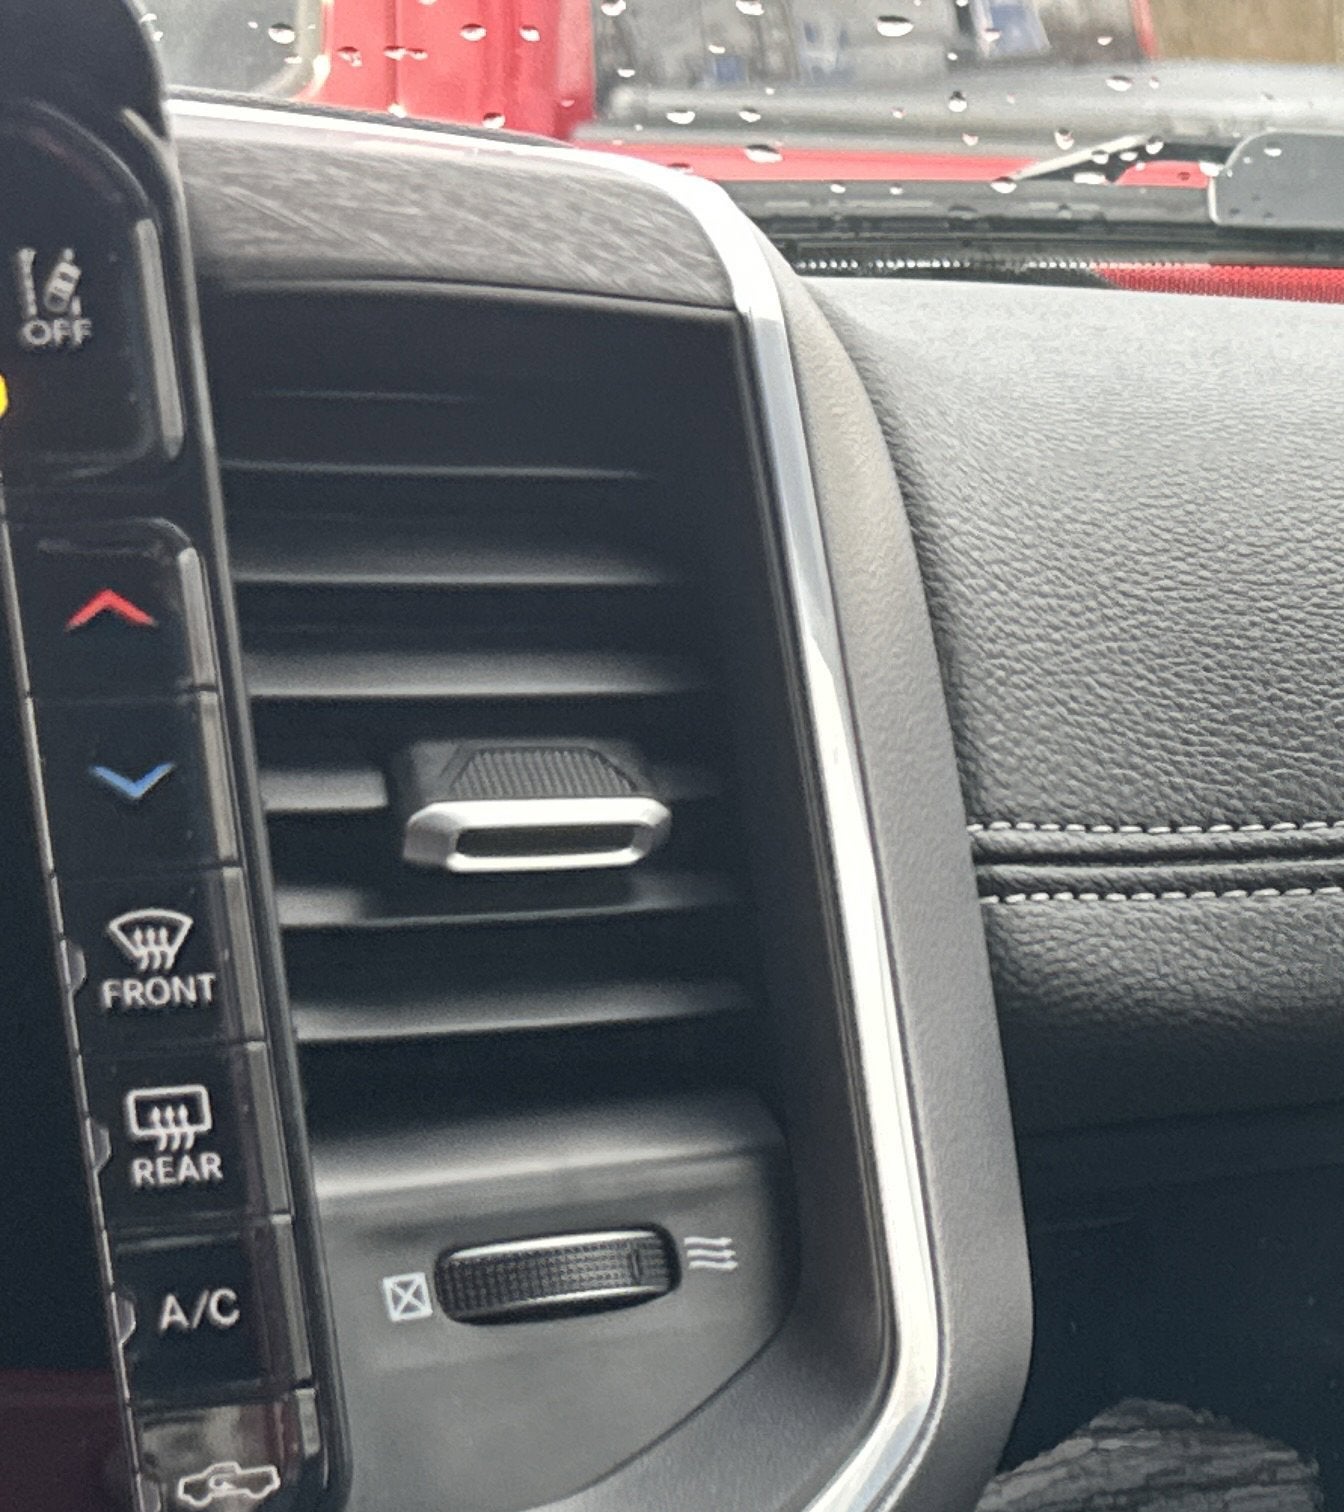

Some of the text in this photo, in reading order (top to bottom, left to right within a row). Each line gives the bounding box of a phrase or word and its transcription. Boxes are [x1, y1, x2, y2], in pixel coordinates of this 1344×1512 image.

[22, 318, 92, 347] OFF
[102, 973, 217, 1008] FRONT
[132, 1153, 224, 1187] REAR
[158, 1289, 241, 1332] A/C
